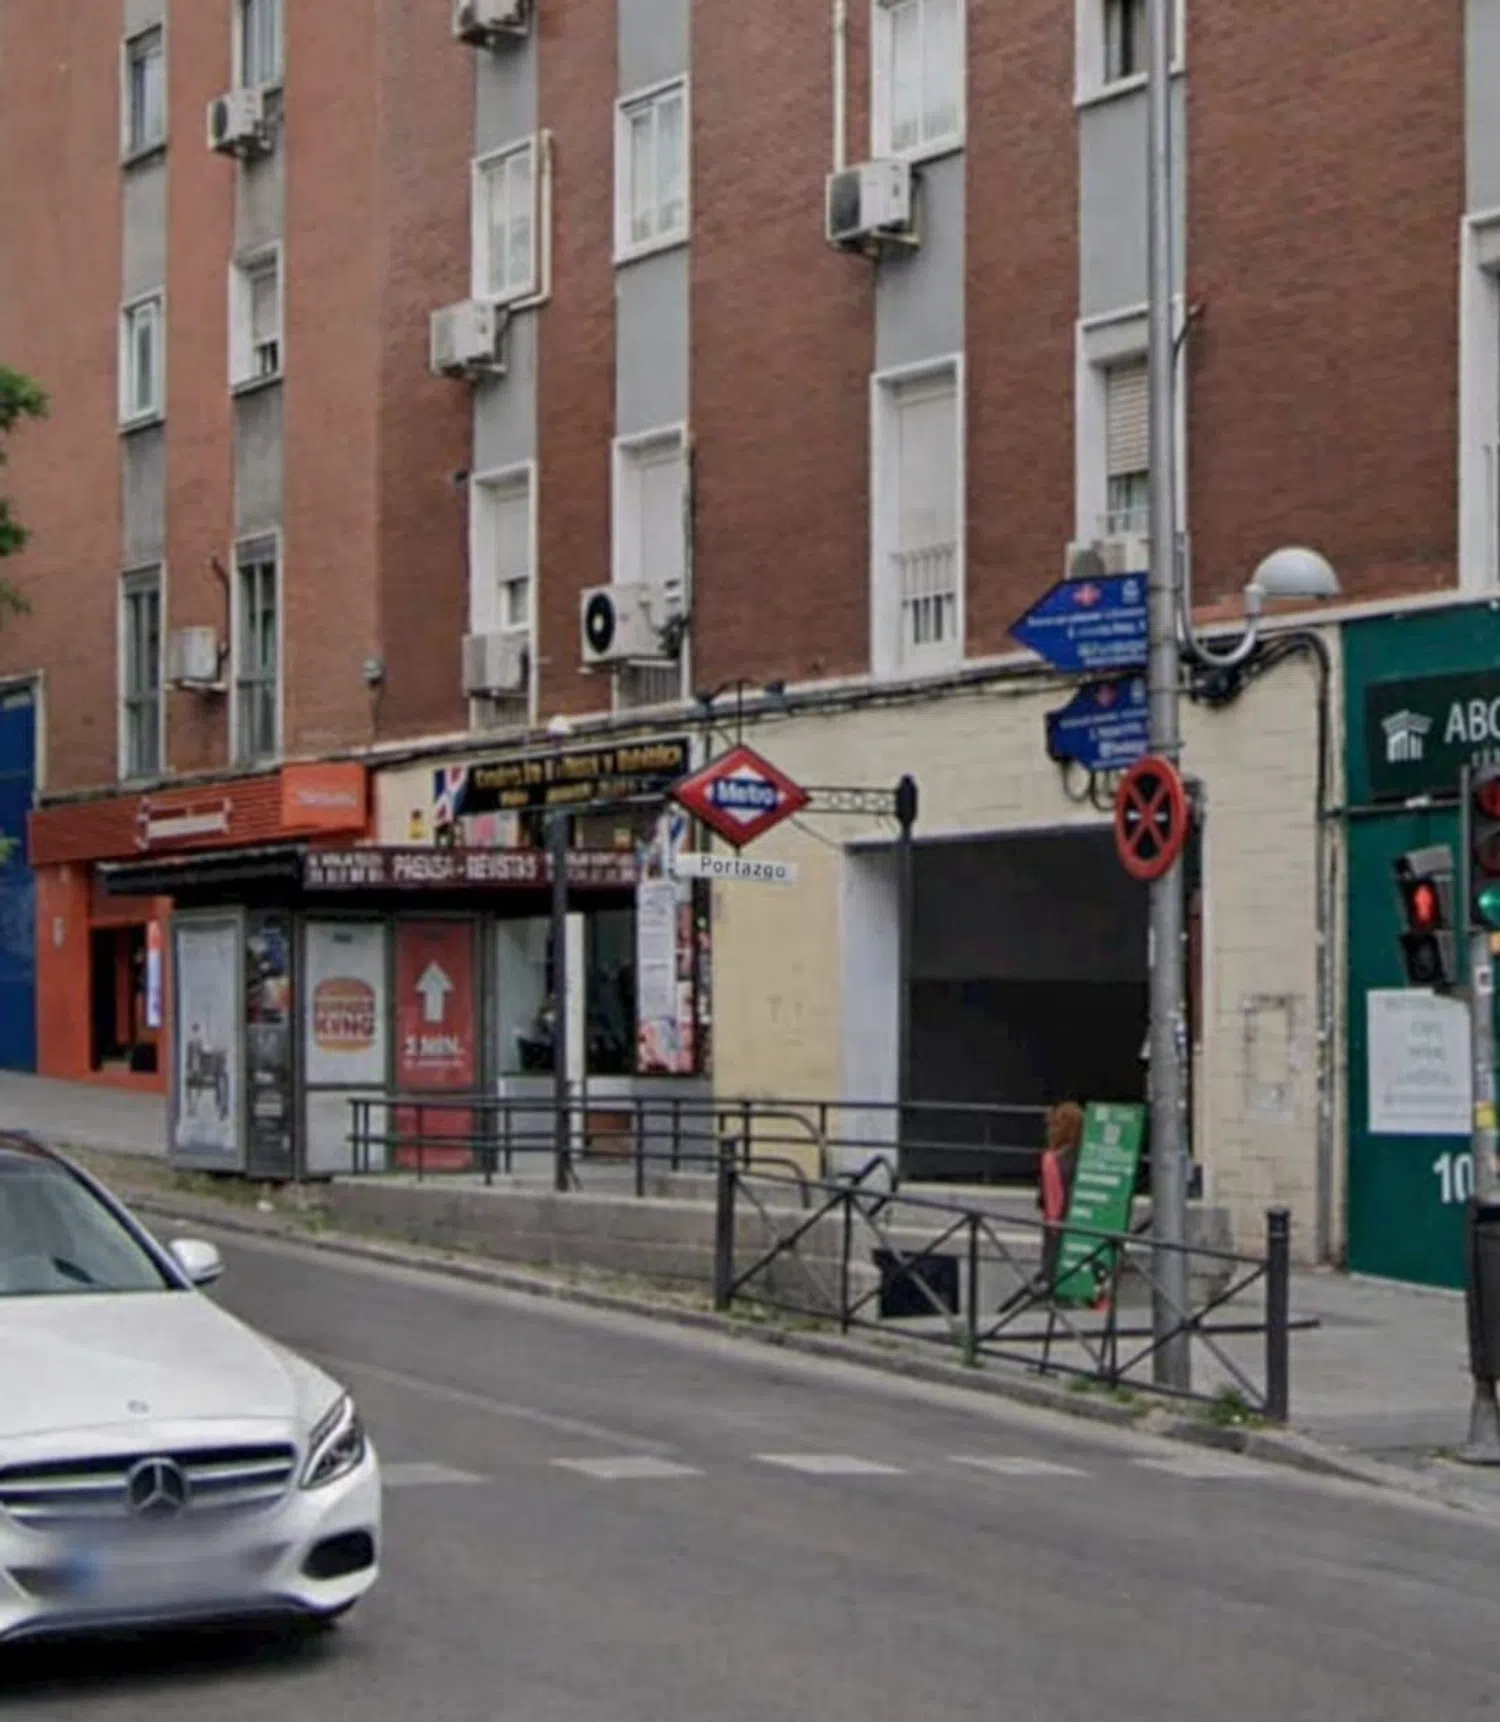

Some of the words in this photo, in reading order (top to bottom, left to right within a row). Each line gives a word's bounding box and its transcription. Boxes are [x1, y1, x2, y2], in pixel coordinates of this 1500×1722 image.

[717, 780, 776, 806] Metro
[393, 854, 455, 879] PRENSA
[701, 856, 787, 880] Portazgo
[1432, 1152, 1475, 1204] 10
